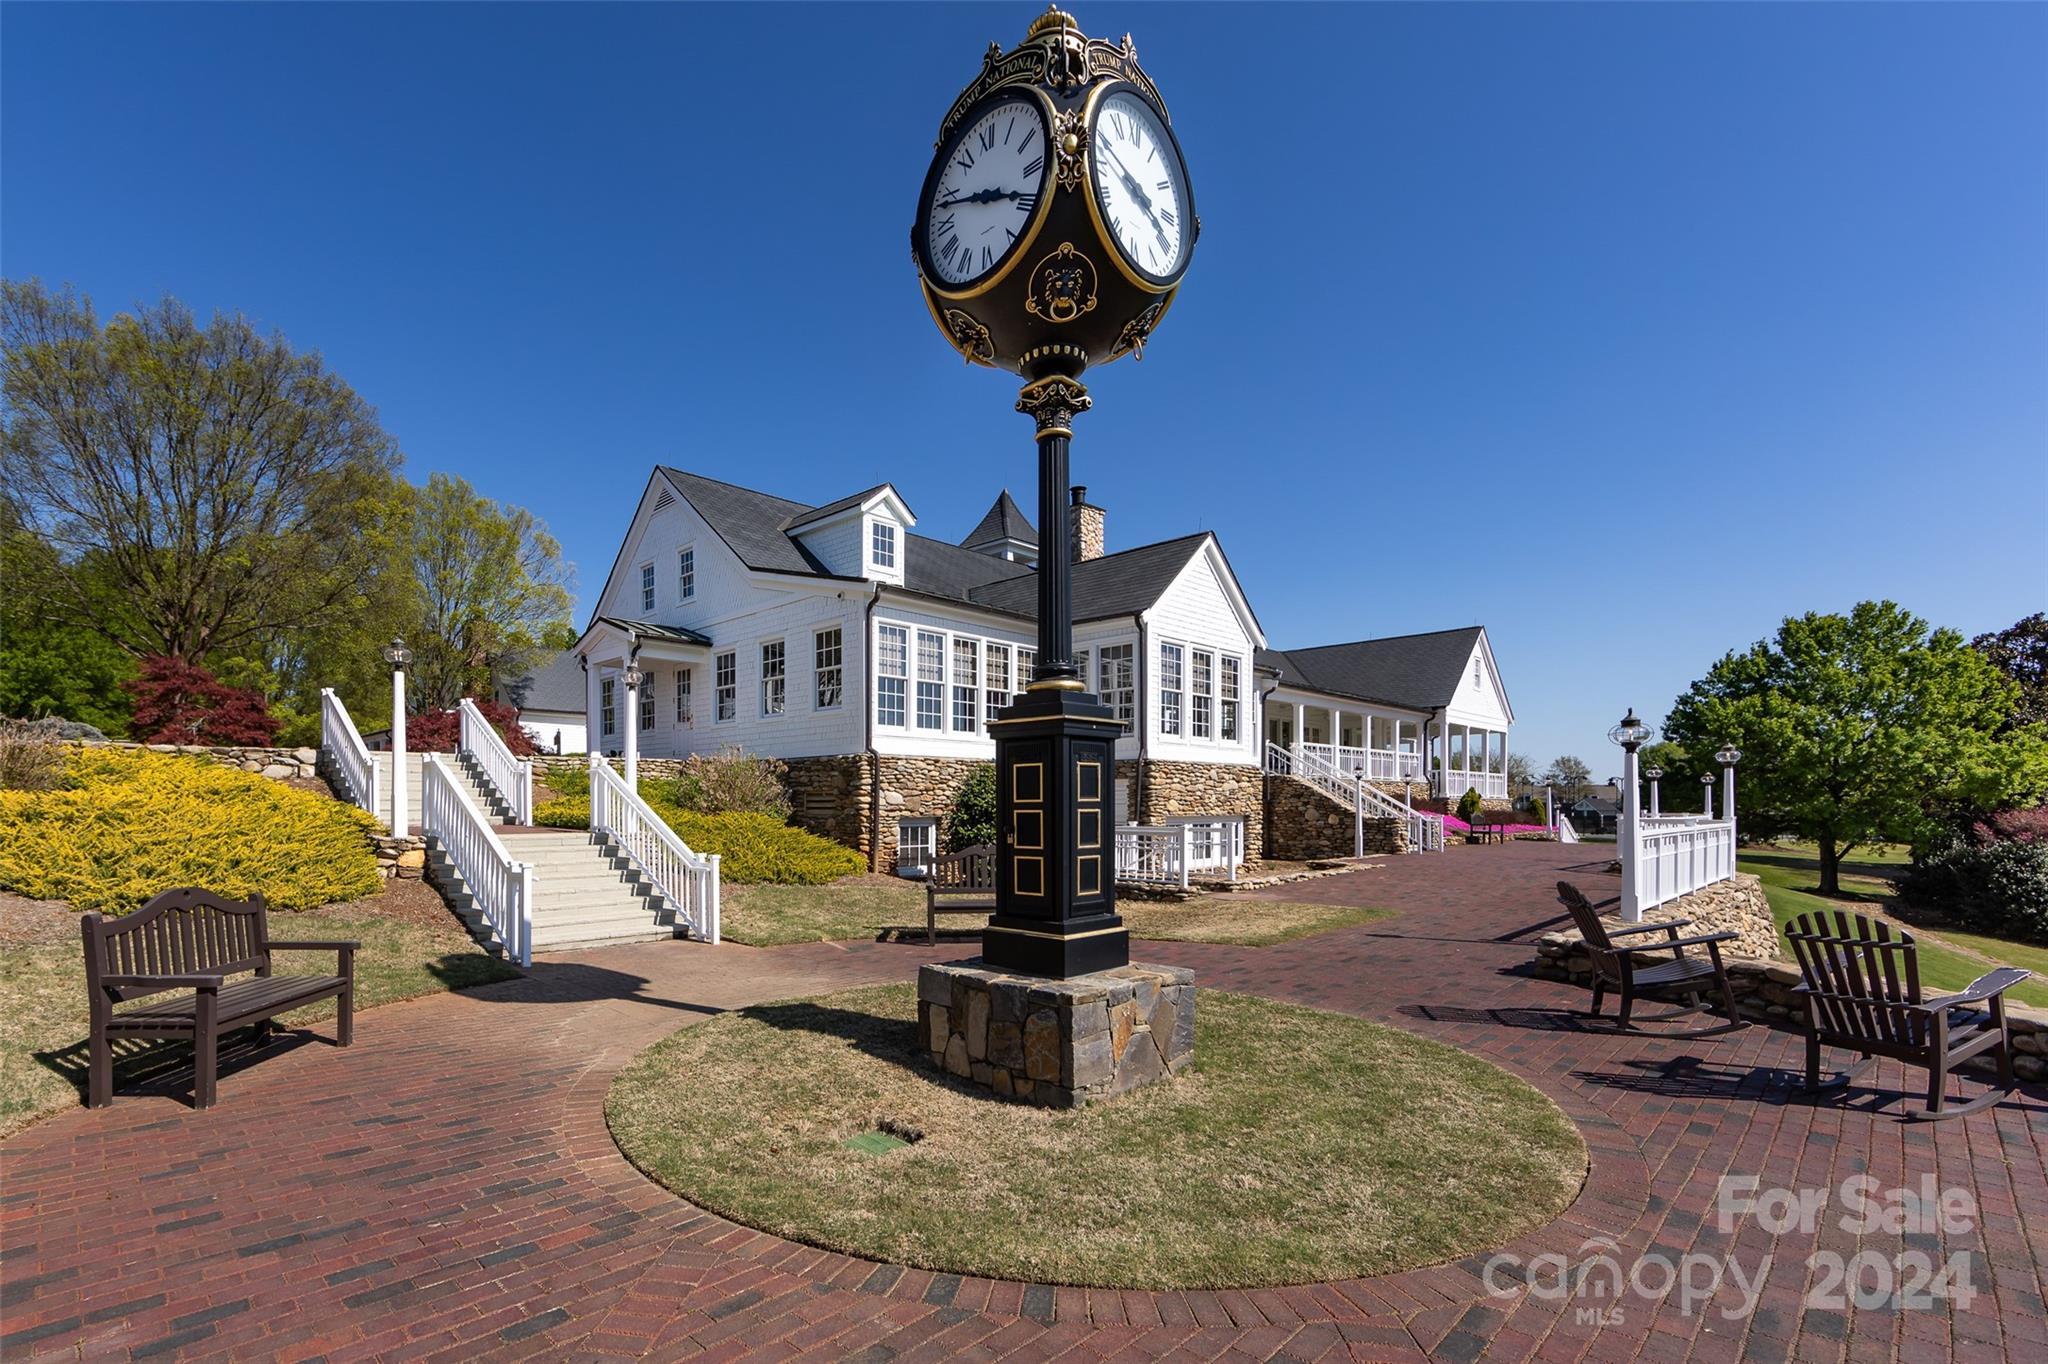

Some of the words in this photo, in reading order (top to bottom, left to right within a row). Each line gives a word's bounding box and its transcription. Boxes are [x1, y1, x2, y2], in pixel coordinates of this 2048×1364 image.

[947, 86, 981, 128] TRUMP
[985, 55, 1037, 89] NATIONAL
[1093, 52, 1121, 69] TRUMP
[1125, 65, 1154, 102] NATIO
